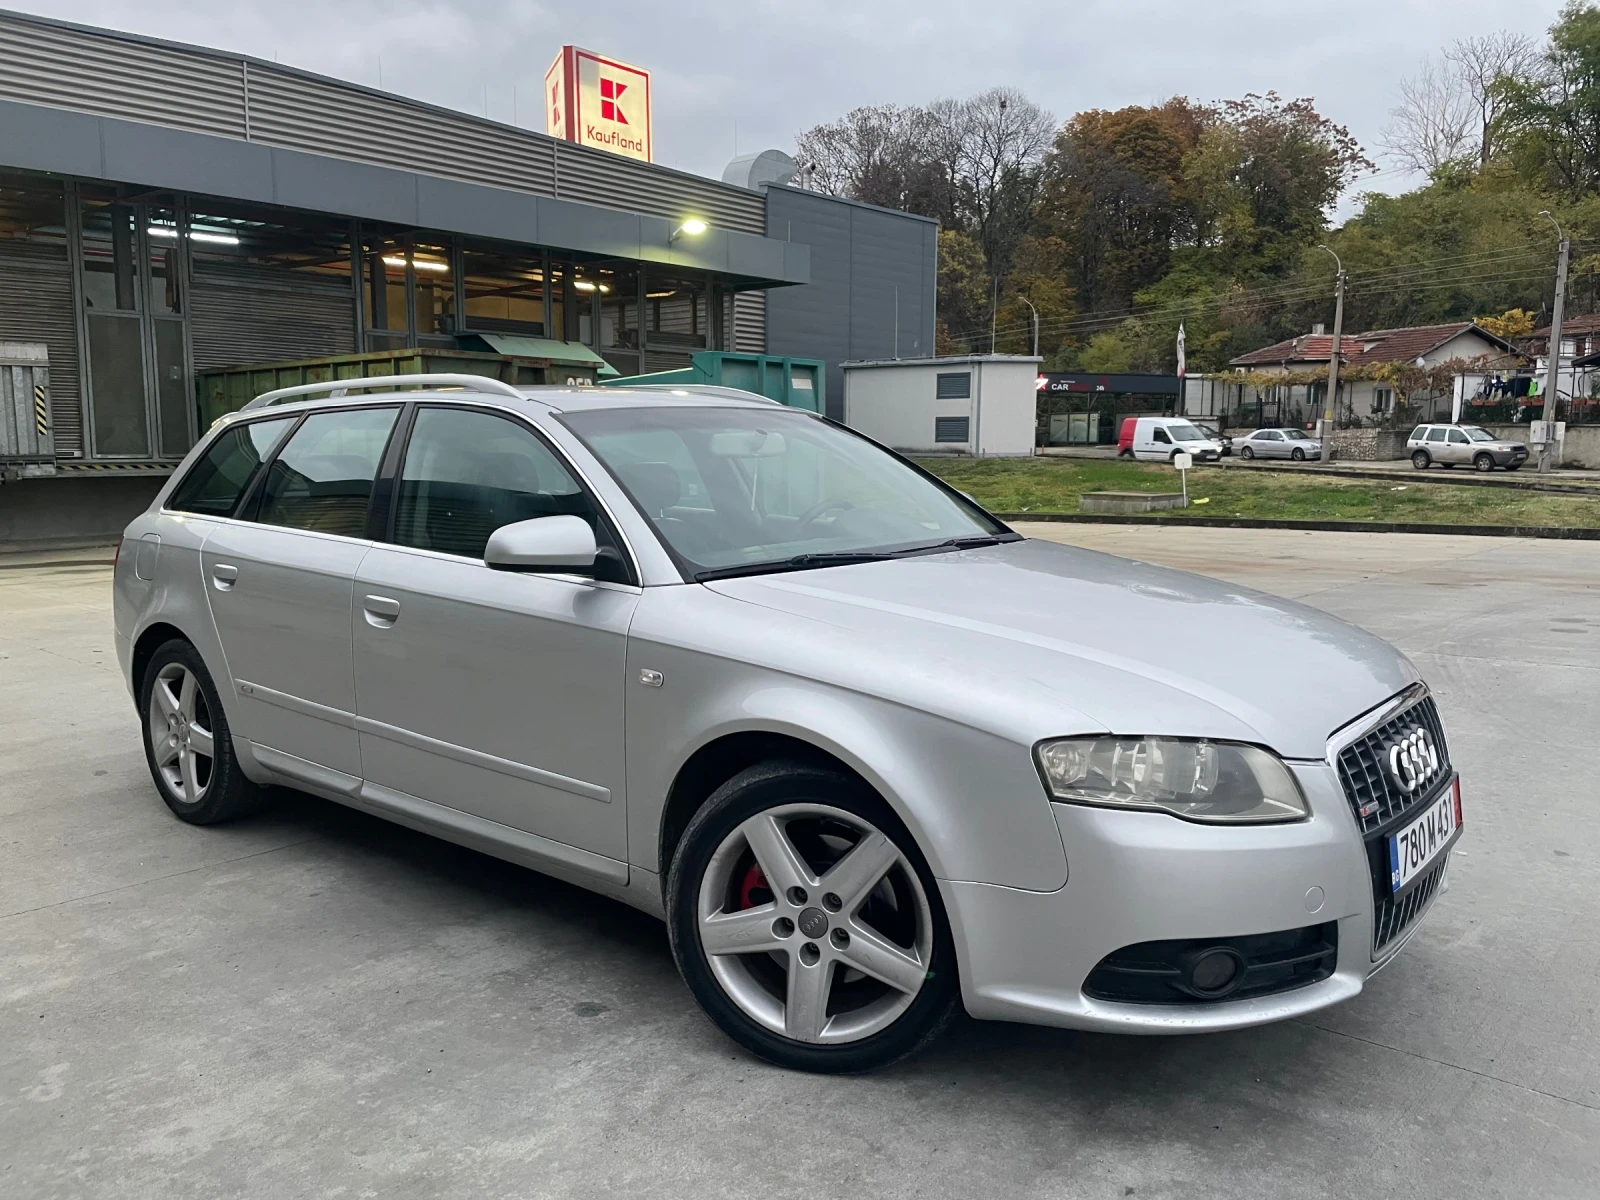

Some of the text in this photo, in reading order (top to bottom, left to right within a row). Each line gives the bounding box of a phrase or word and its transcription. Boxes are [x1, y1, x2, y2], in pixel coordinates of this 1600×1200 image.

[587, 124, 642, 152] Kaufland
[1051, 383, 1069, 391] CAR
[1400, 821, 1426, 878] 780
[1438, 792, 1454, 840] 431
[1391, 869, 1400, 885] BG
